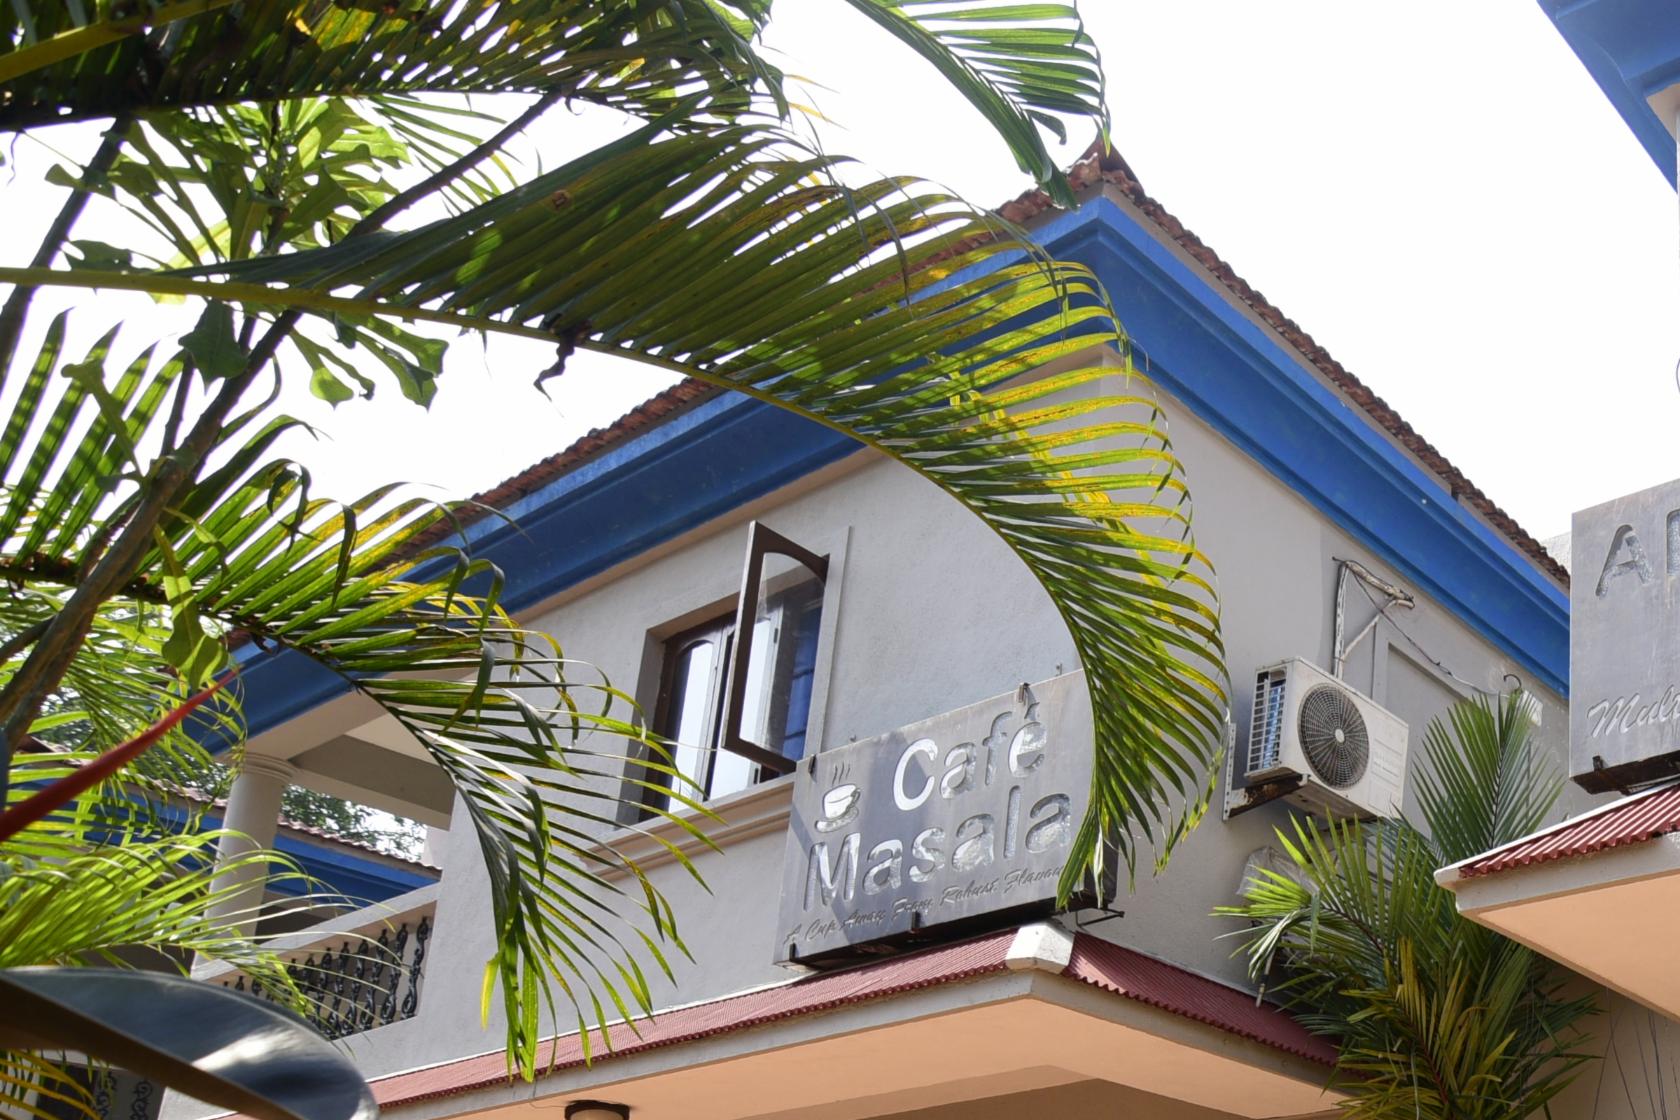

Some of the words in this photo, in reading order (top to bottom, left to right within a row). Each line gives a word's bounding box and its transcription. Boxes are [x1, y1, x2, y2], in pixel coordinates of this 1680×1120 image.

[893, 702, 1047, 811] Café
[803, 785, 1072, 912] Masala
[805, 918, 836, 941] Cup
[940, 877, 998, 906] Robust
